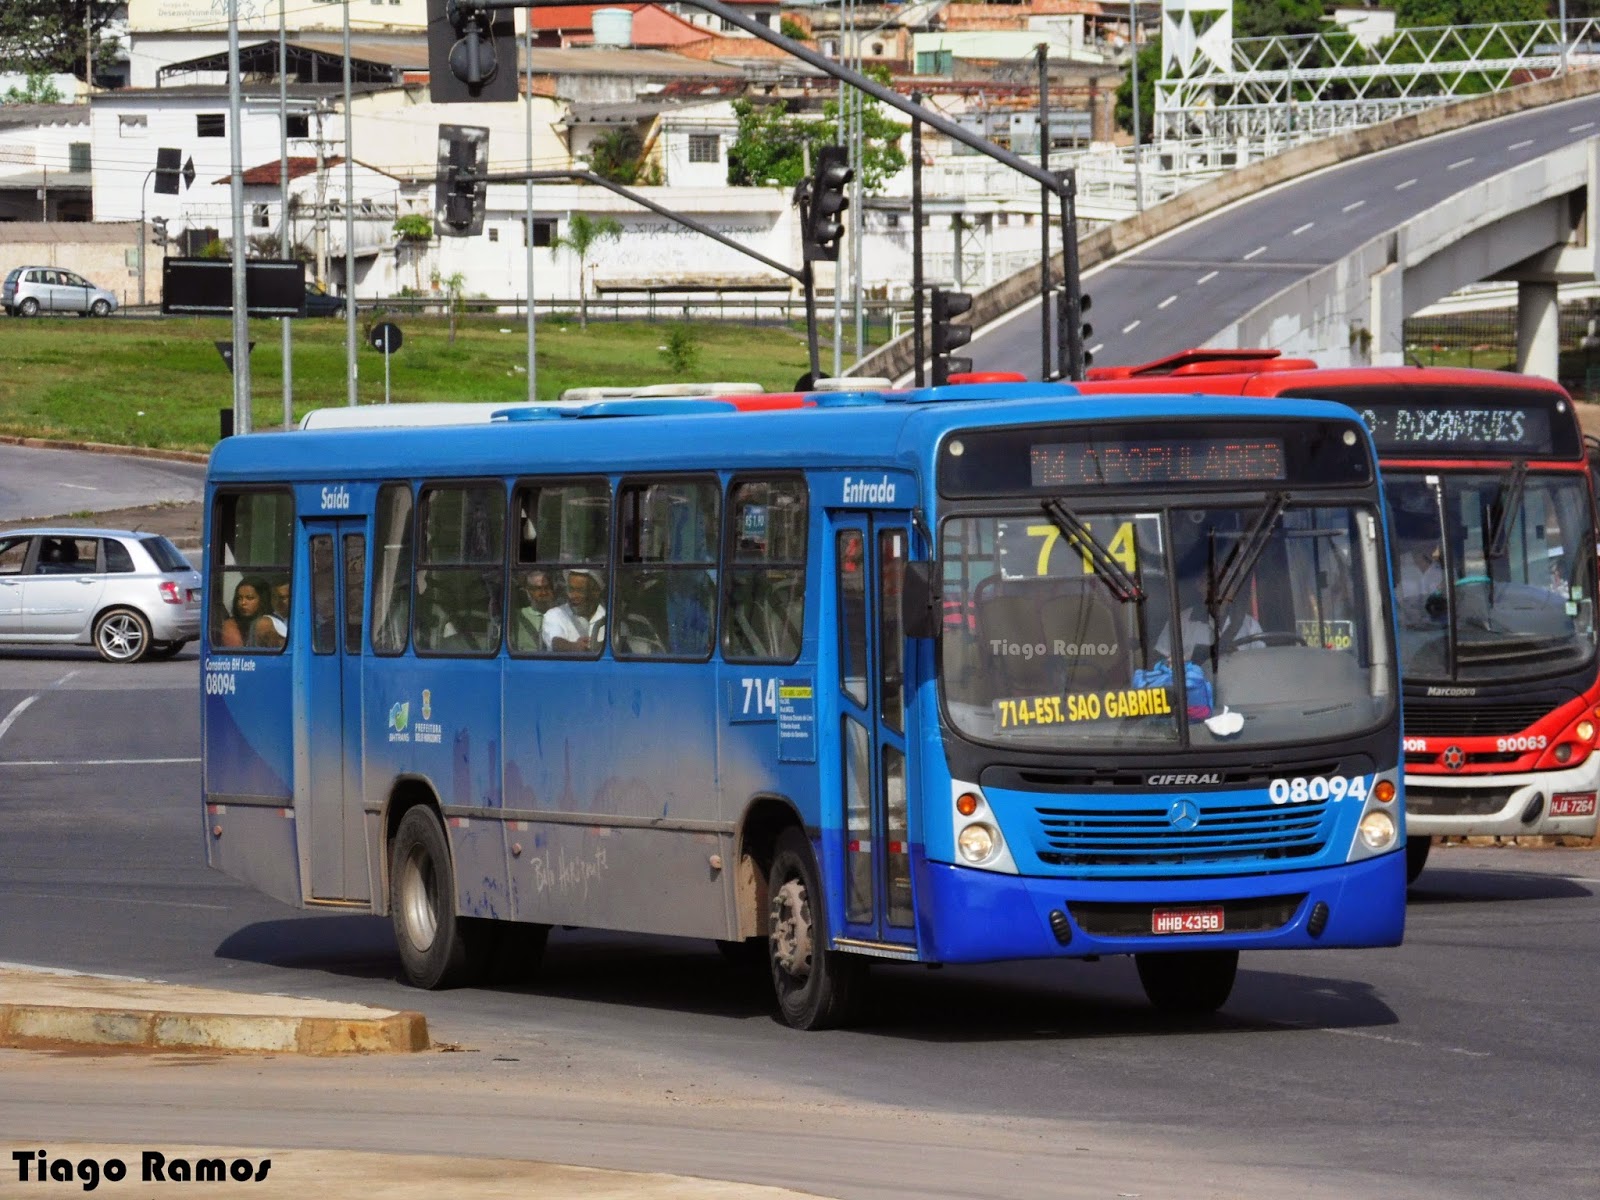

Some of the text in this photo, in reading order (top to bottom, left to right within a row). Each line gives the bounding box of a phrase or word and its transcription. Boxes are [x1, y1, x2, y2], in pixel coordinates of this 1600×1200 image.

[321, 485, 350, 509] Saída
[843, 474, 896, 503] Entrada
[1026, 522, 1137, 576] 714
[231, 657, 240, 671] BH
[241, 657, 256, 671] Leste
[206, 672, 236, 695] 08094
[741, 677, 777, 714] 714
[998, 687, 1172, 727] 714-EST. SAO GABRIEL
[1496, 735, 1548, 752] 90063
[1147, 773, 1221, 786] CIFERAL
[1268, 775, 1368, 805] 08094
